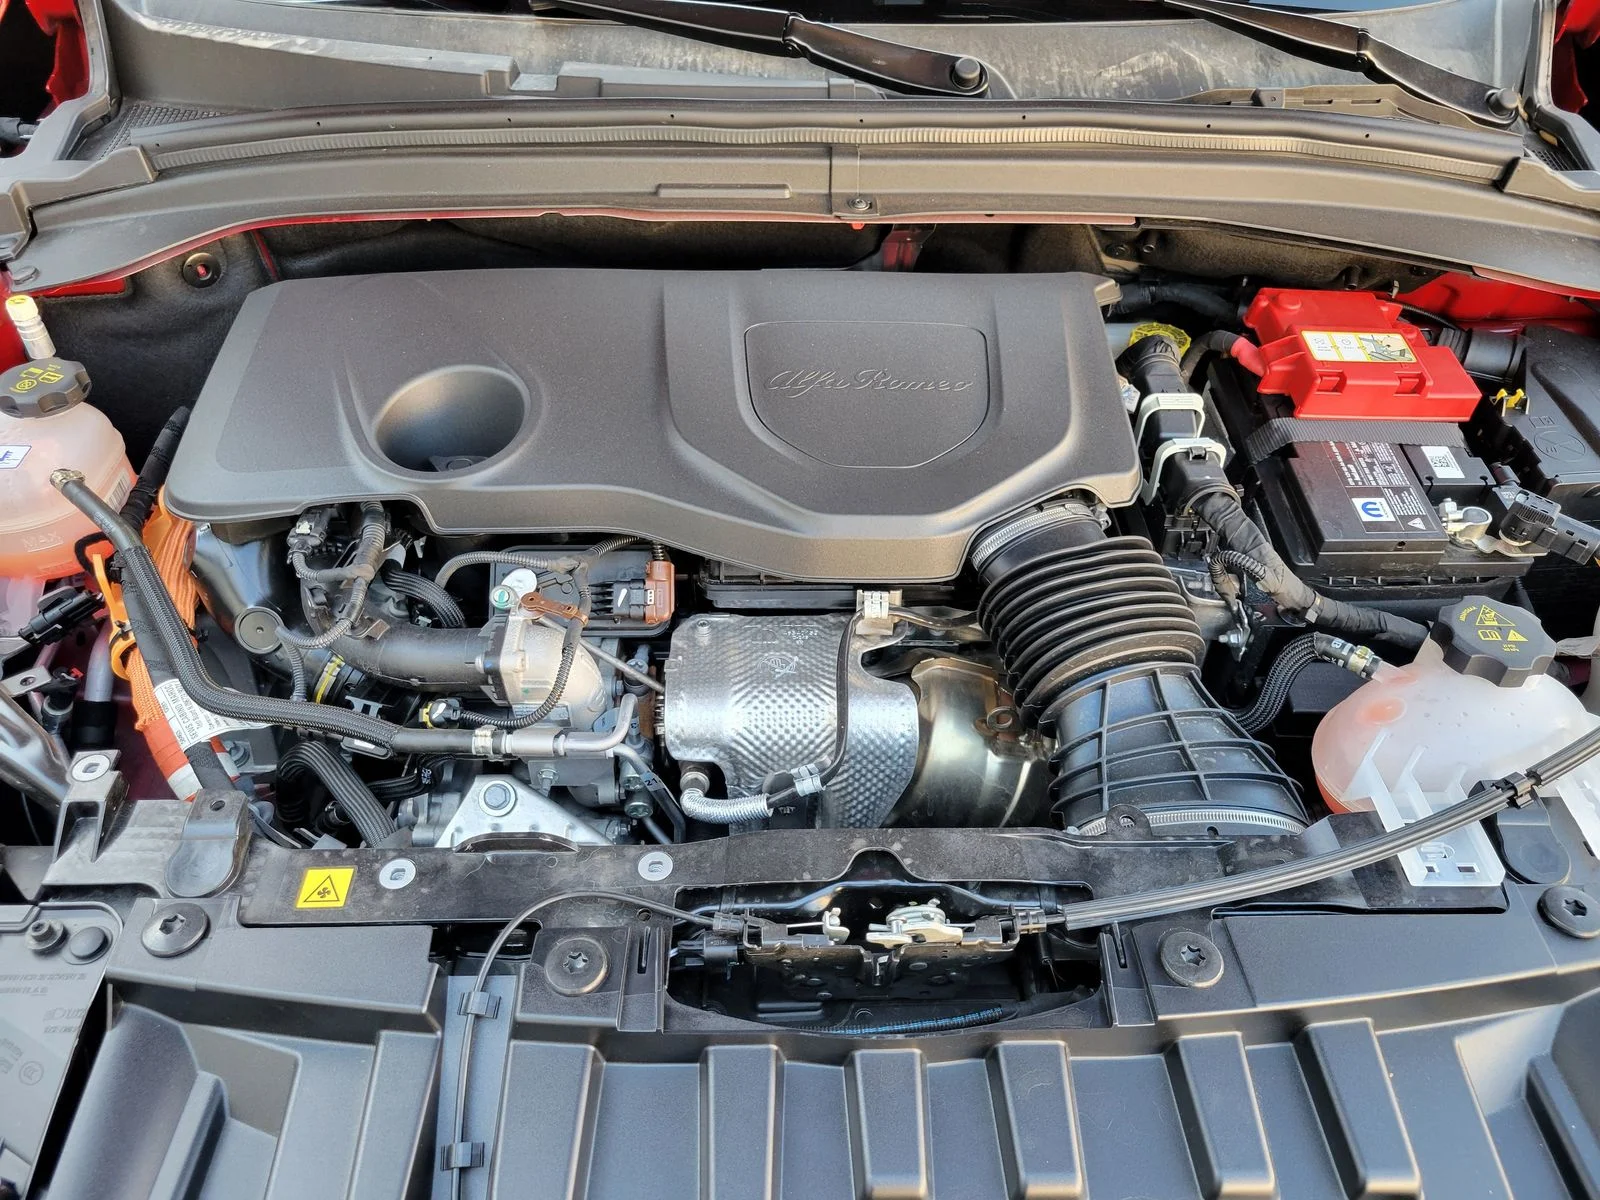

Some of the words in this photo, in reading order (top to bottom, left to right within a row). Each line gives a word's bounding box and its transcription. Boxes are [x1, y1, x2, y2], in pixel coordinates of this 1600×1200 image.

[767, 370, 850, 398] Alfa
[853, 368, 974, 391] Romeo
[644, 778, 657, 786] 21
